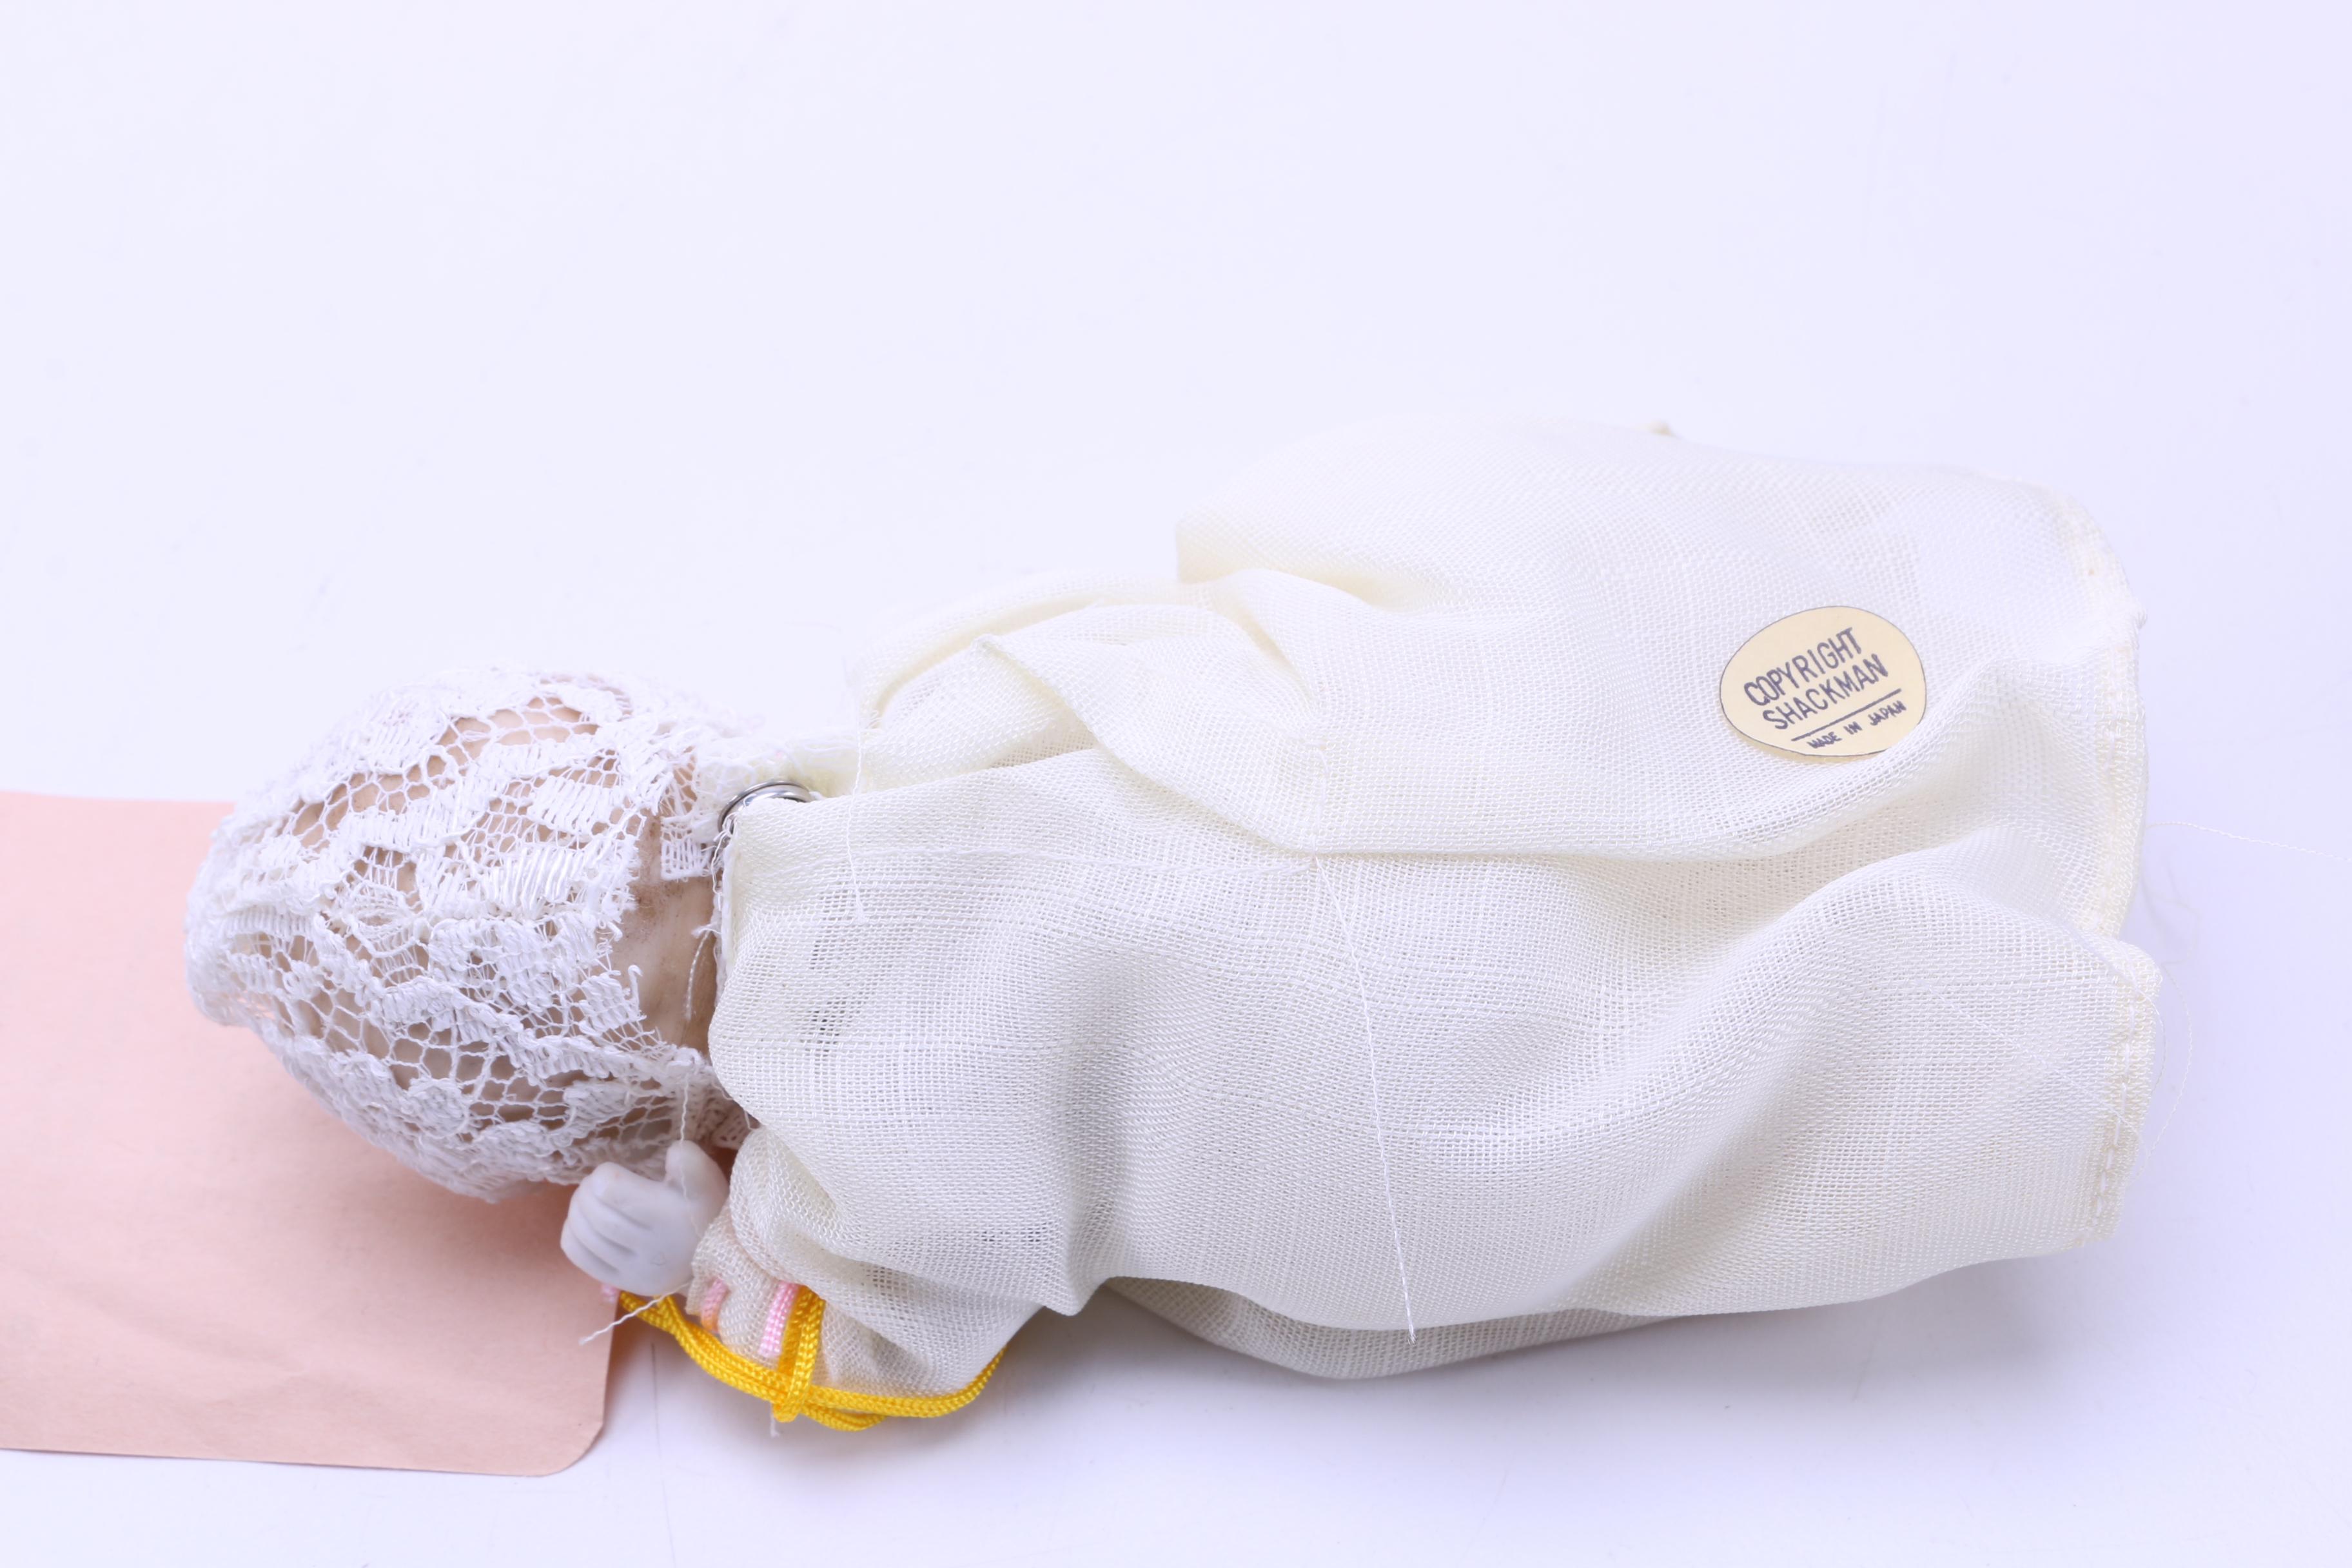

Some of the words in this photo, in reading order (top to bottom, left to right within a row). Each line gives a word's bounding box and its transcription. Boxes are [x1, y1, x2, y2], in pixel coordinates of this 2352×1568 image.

[1743, 627, 1862, 706] COPYRIGHT
[1762, 653, 1888, 730] SHACKMAN
[1807, 731, 1843, 749] MADE
[1843, 721, 1863, 735] IN
[1868, 700, 1906, 726] JAPAN
